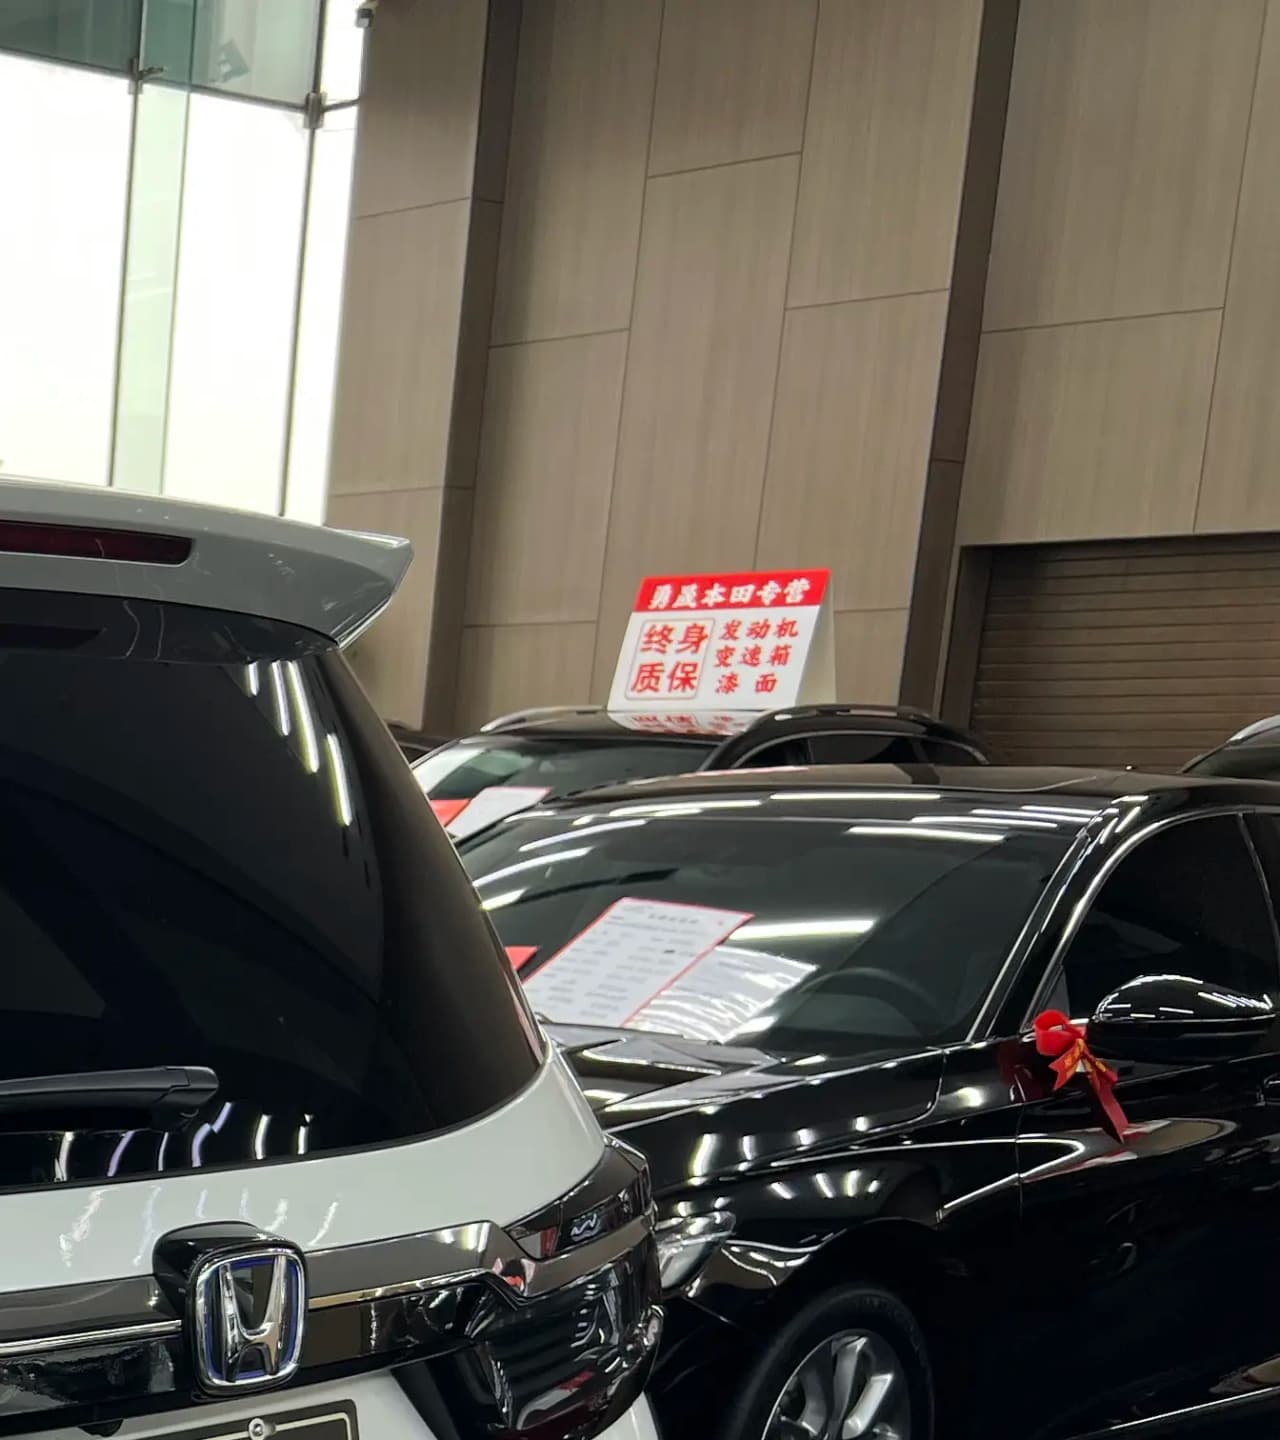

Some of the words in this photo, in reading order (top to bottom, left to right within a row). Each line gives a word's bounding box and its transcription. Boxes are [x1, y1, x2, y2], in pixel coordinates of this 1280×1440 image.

[641, 623, 709, 655] 终身
[718, 617, 800, 642] 发动机
[713, 644, 793, 669] 变速箱
[630, 660, 700, 695] 质保
